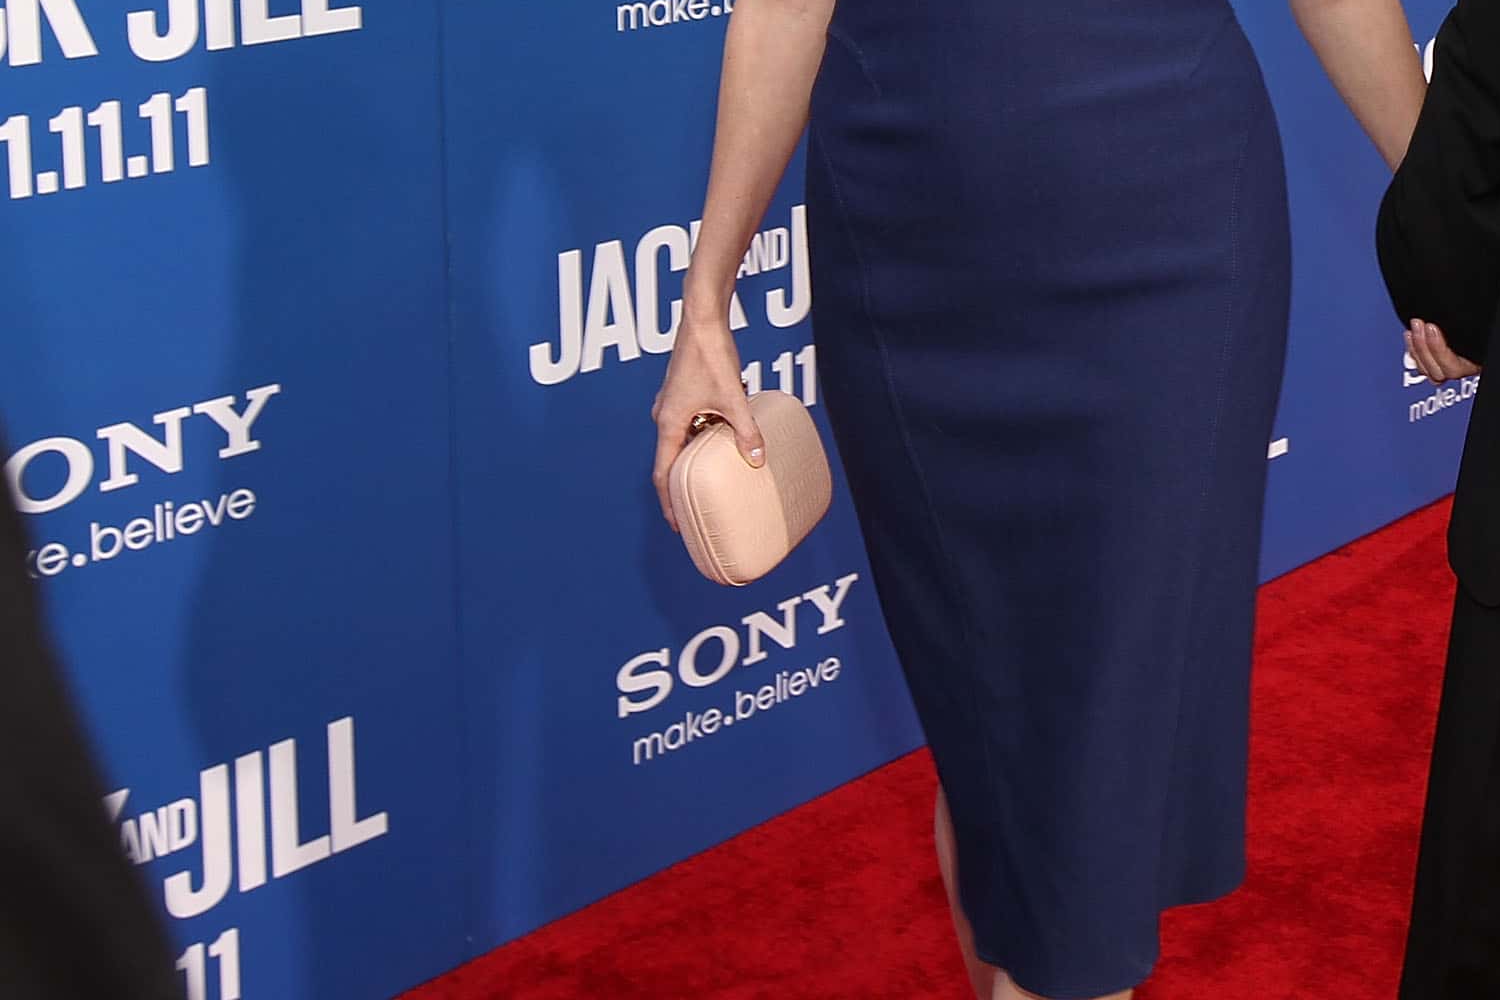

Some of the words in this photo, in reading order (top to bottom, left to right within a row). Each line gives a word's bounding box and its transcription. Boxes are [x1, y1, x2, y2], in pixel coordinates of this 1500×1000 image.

[4, 384, 281, 515] ONY
[616, 573, 859, 718] SONY
[633, 656, 842, 766] make.believe
[164, 716, 389, 920] JILL
